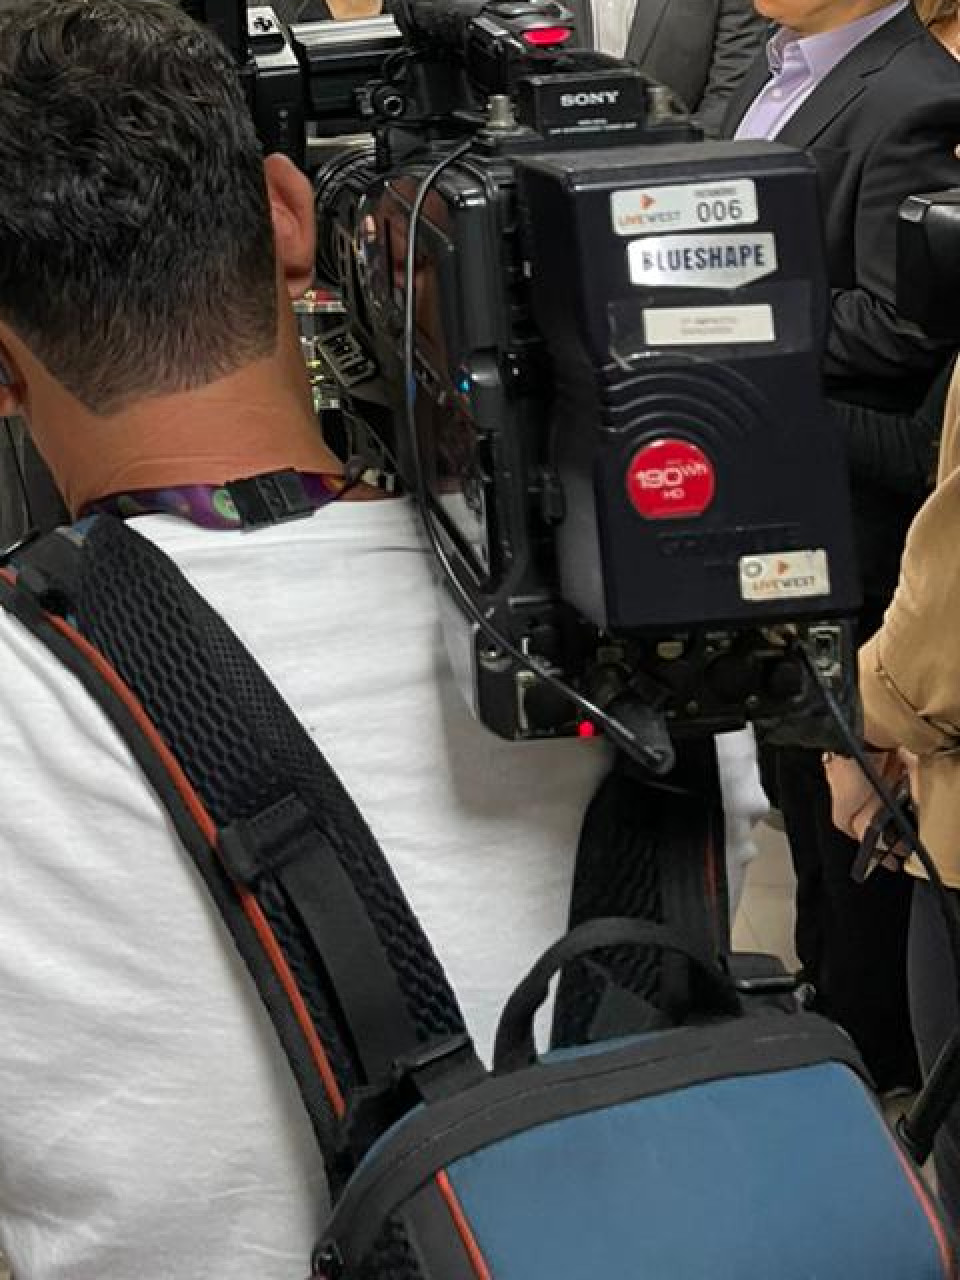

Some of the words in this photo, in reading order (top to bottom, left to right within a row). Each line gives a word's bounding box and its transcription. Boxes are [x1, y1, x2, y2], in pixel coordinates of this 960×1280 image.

[559, 90, 620, 107] SONY
[695, 199, 743, 223] 006
[641, 243, 766, 272] BLUESHAPE
